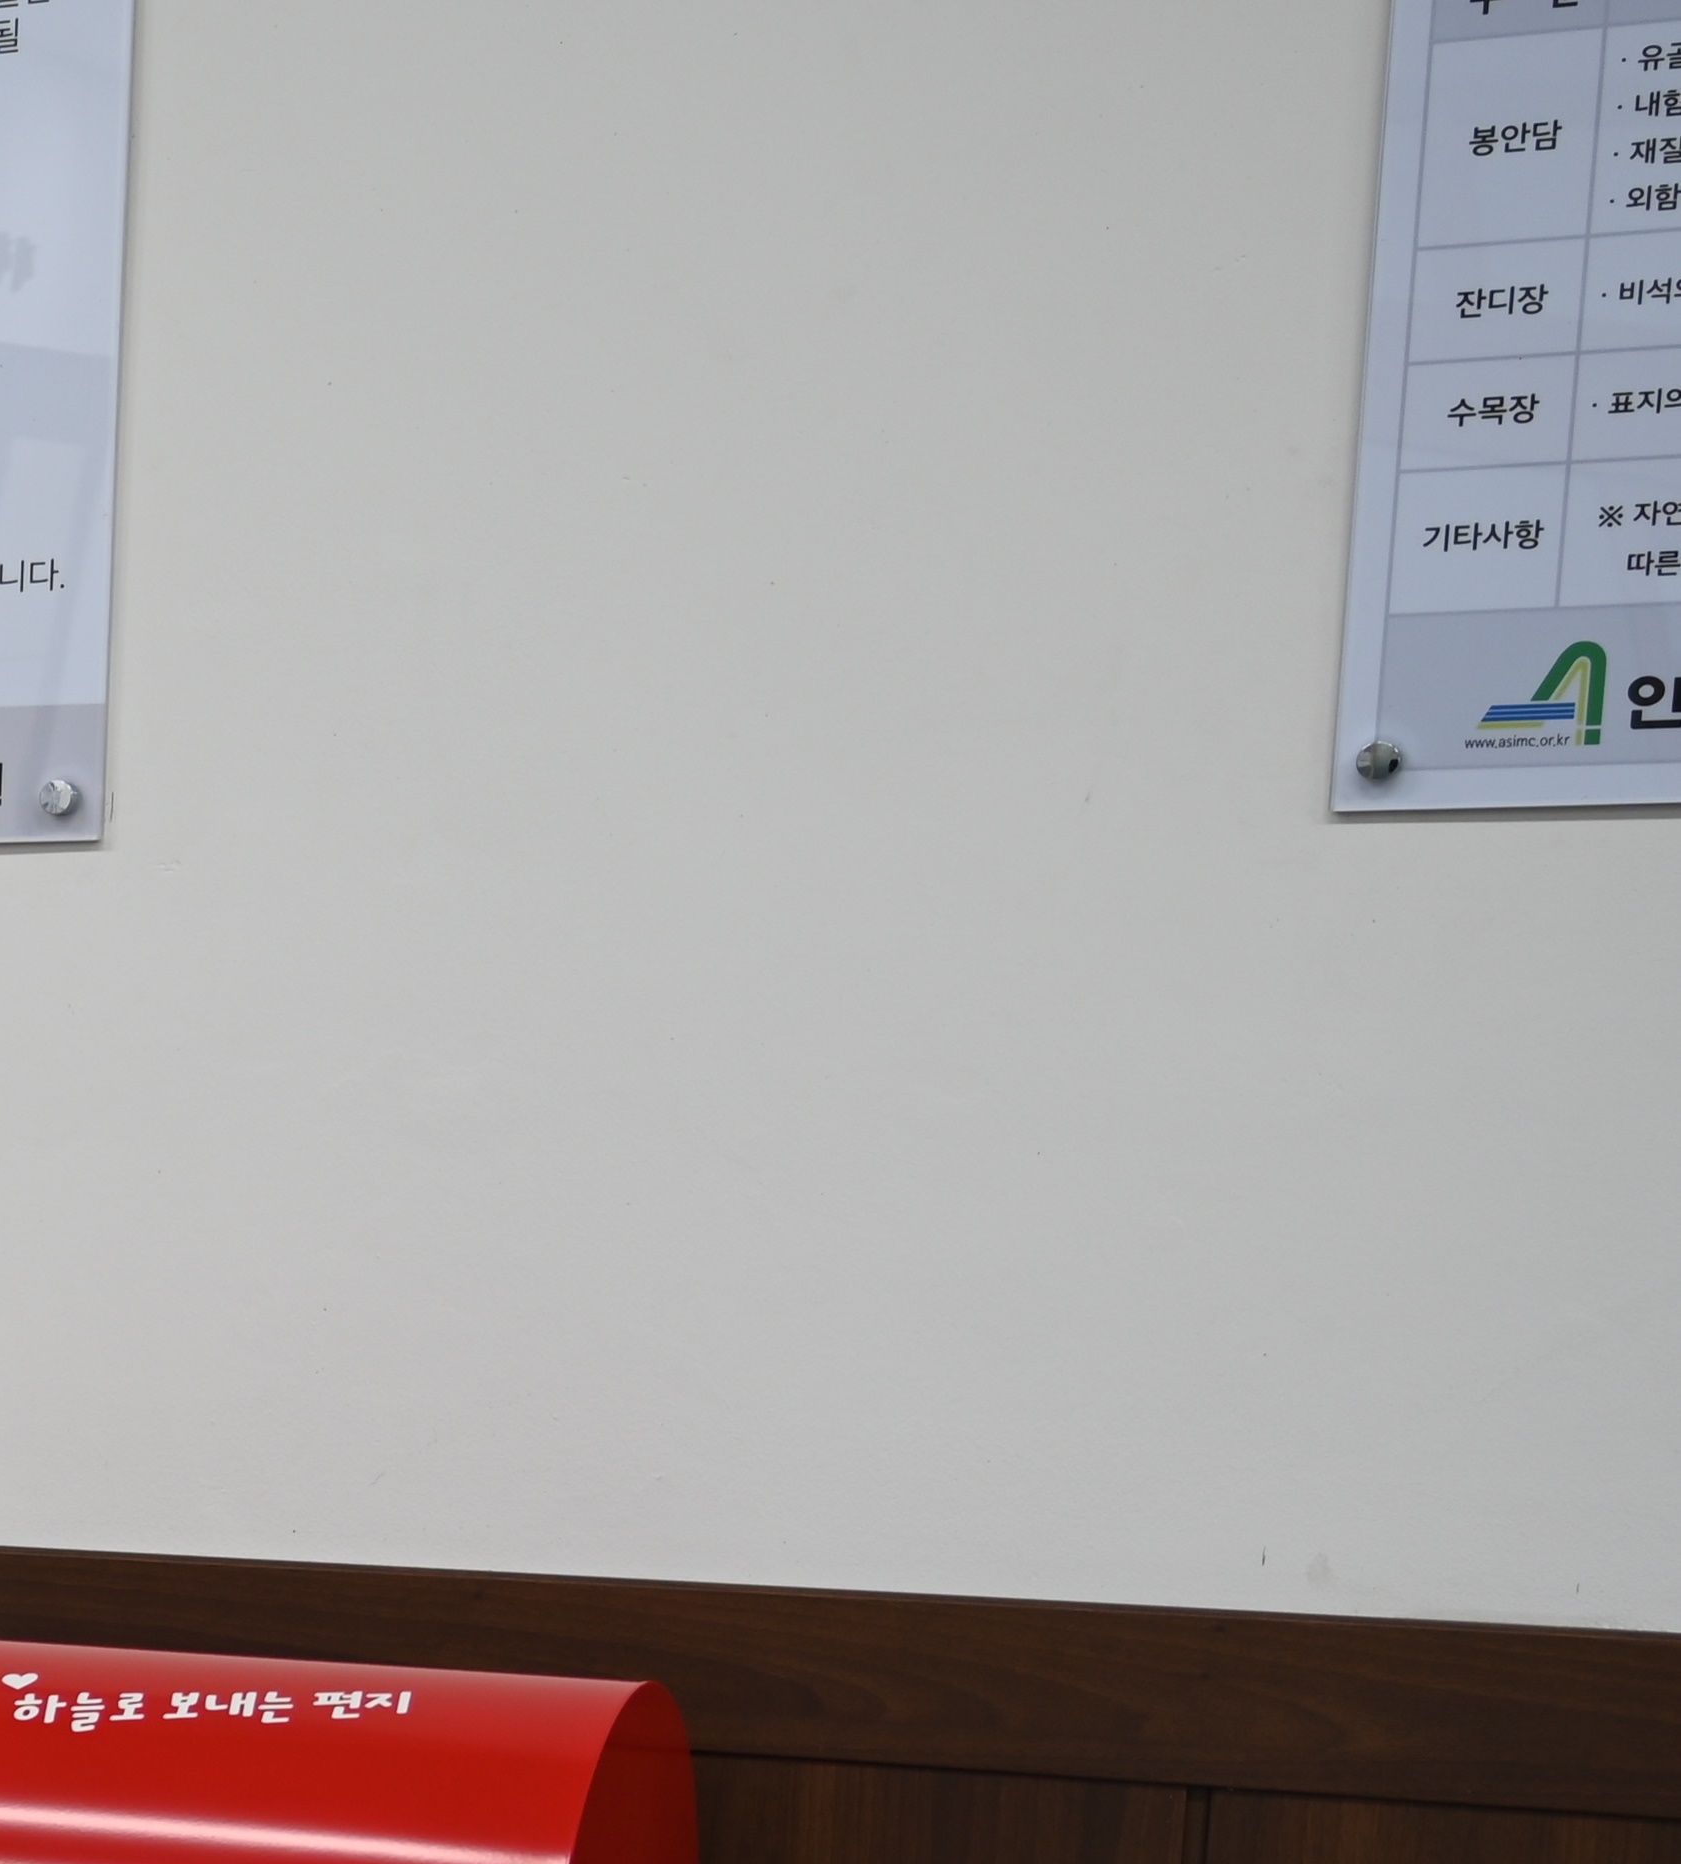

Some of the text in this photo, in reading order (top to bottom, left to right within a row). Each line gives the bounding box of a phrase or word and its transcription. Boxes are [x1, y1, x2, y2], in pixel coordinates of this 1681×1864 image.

[1468, 119, 1563, 156] 봉안담
[1454, 283, 1550, 320] 잔디장
[1446, 392, 1540, 428] 수목장
[1421, 518, 1545, 553] 기타사항
[1464, 733, 1571, 750] www.asimc.or.kr
[12, 1689, 413, 1734] 하늘로 보내는 편지
